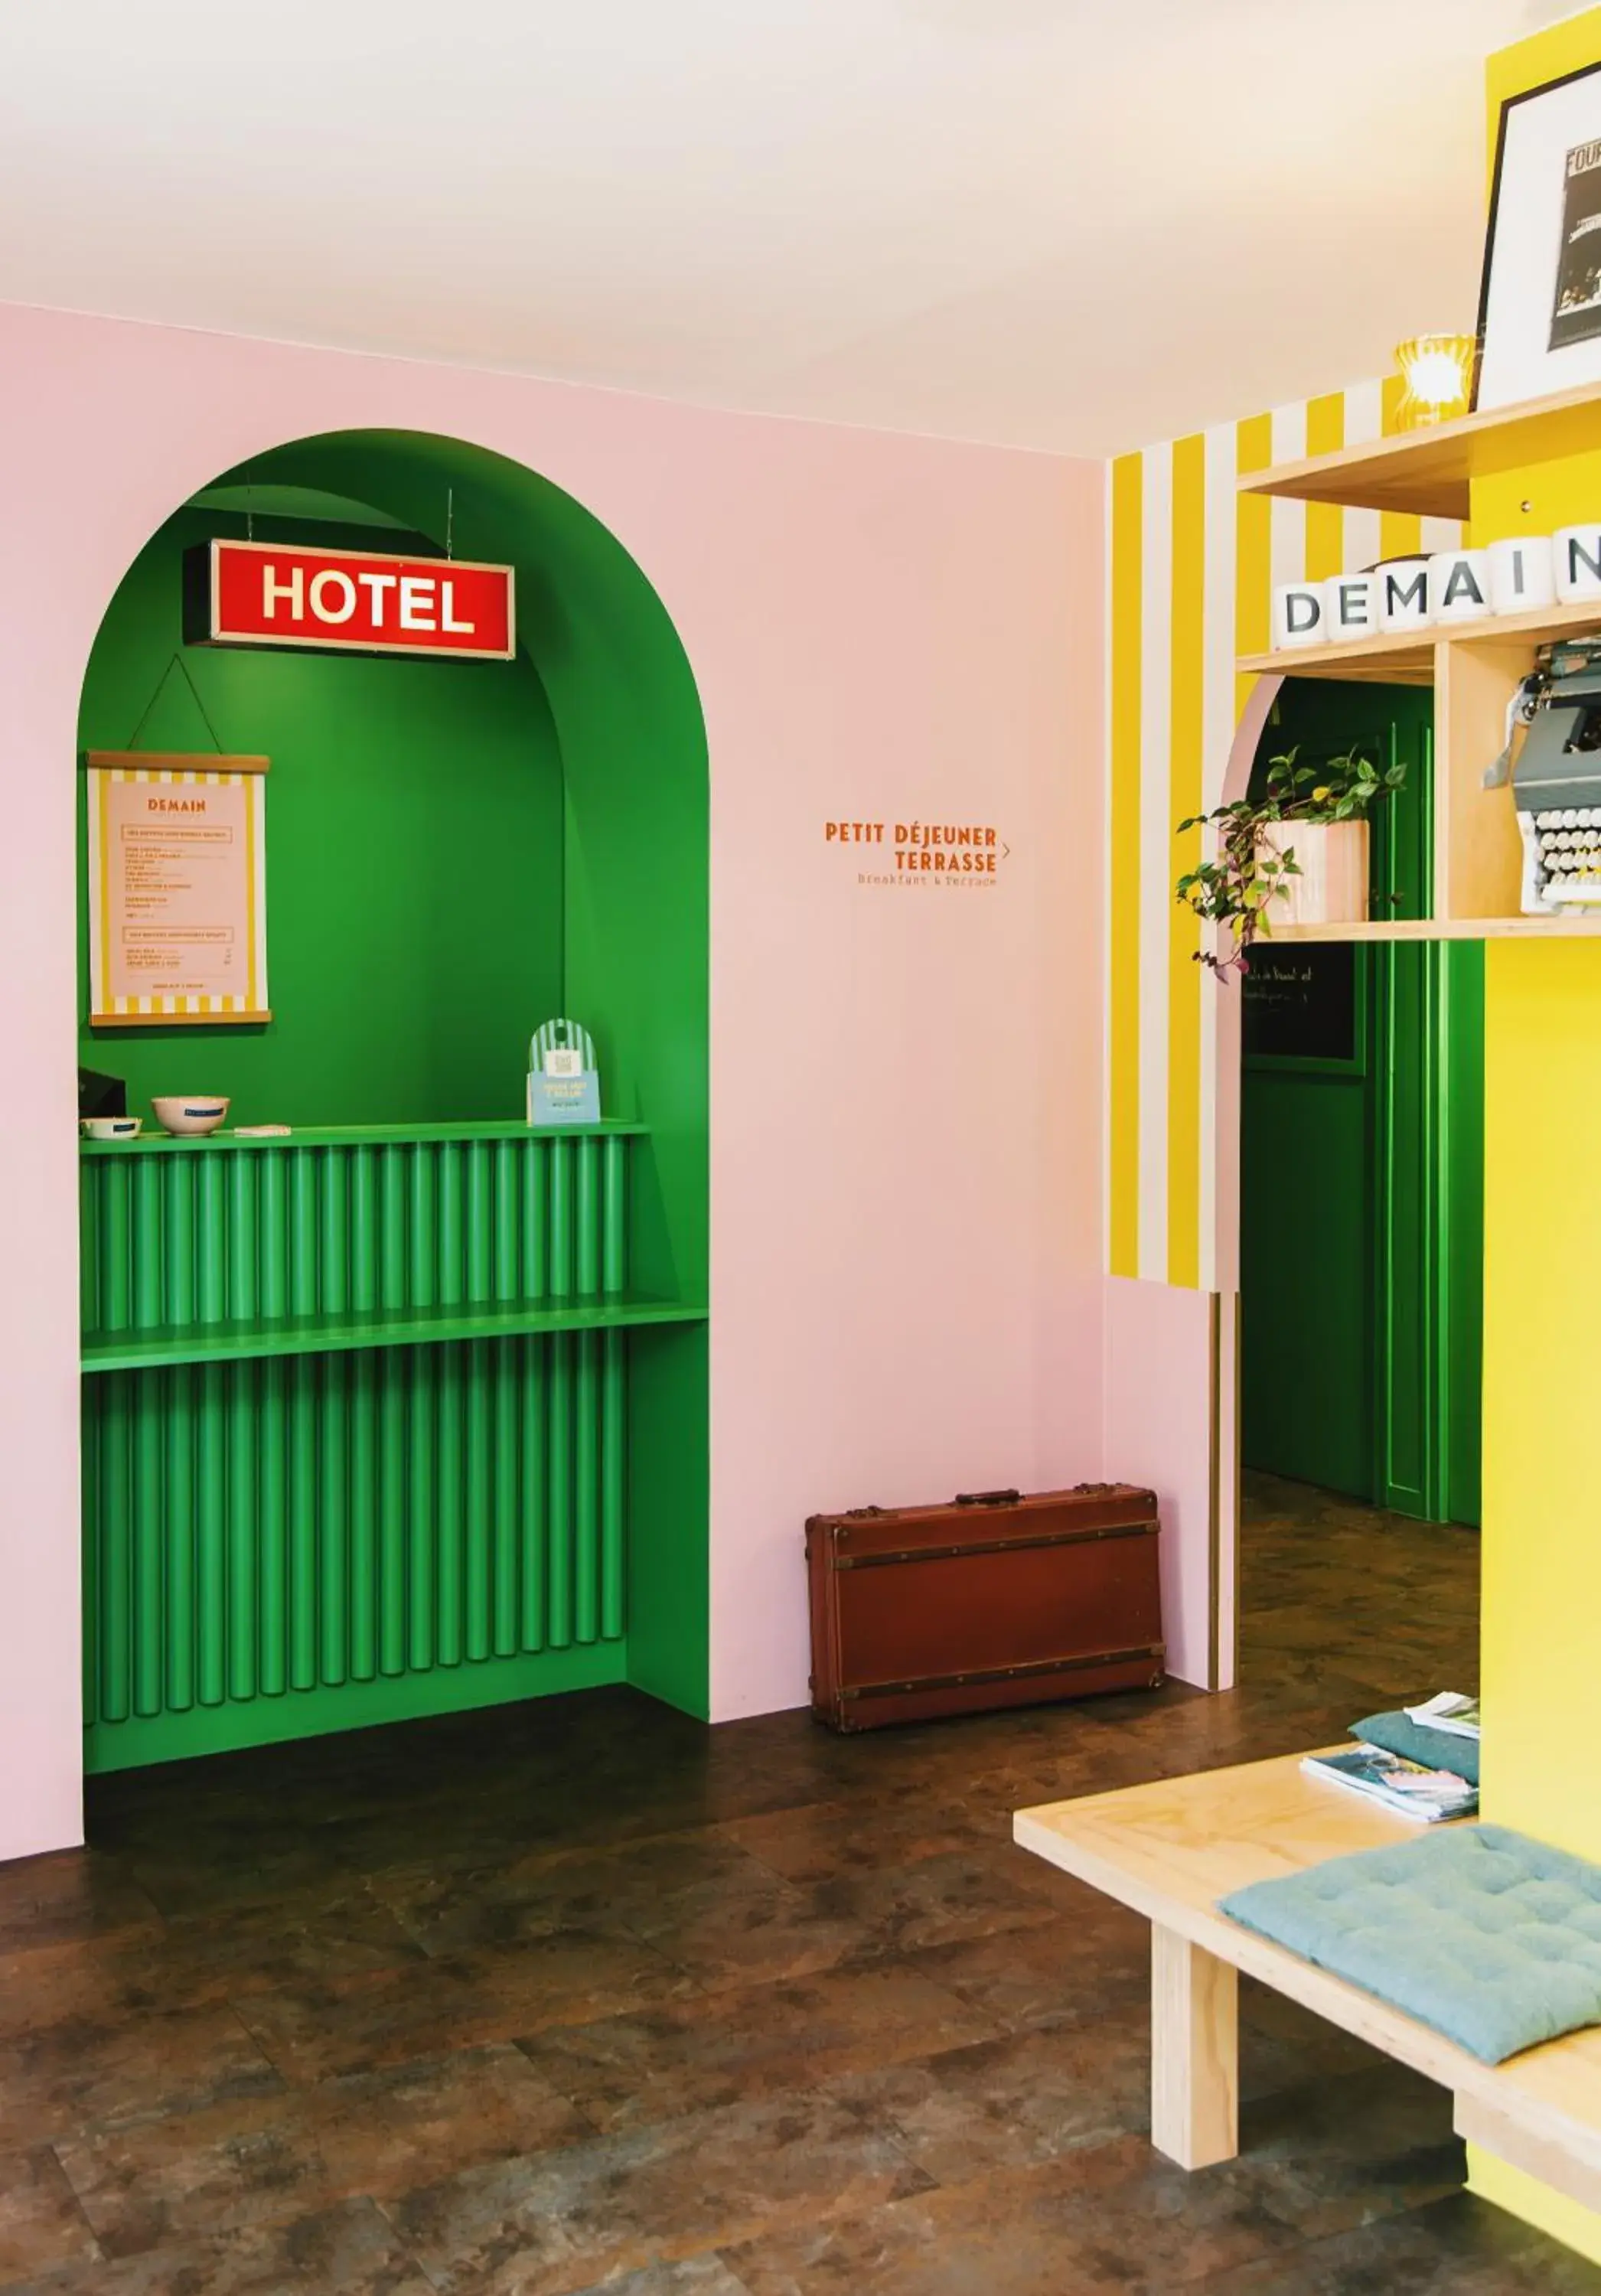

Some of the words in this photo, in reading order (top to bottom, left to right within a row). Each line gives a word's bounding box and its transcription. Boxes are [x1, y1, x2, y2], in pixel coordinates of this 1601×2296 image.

[1286, 534, 1601, 633] DEMAIN
[263, 565, 474, 634] HOTEL
[148, 798, 205, 812] DEMAIN
[826, 822, 884, 843] PETIT
[895, 821, 996, 849] DÉJEUNER
[895, 851, 996, 872] TERRASSE
